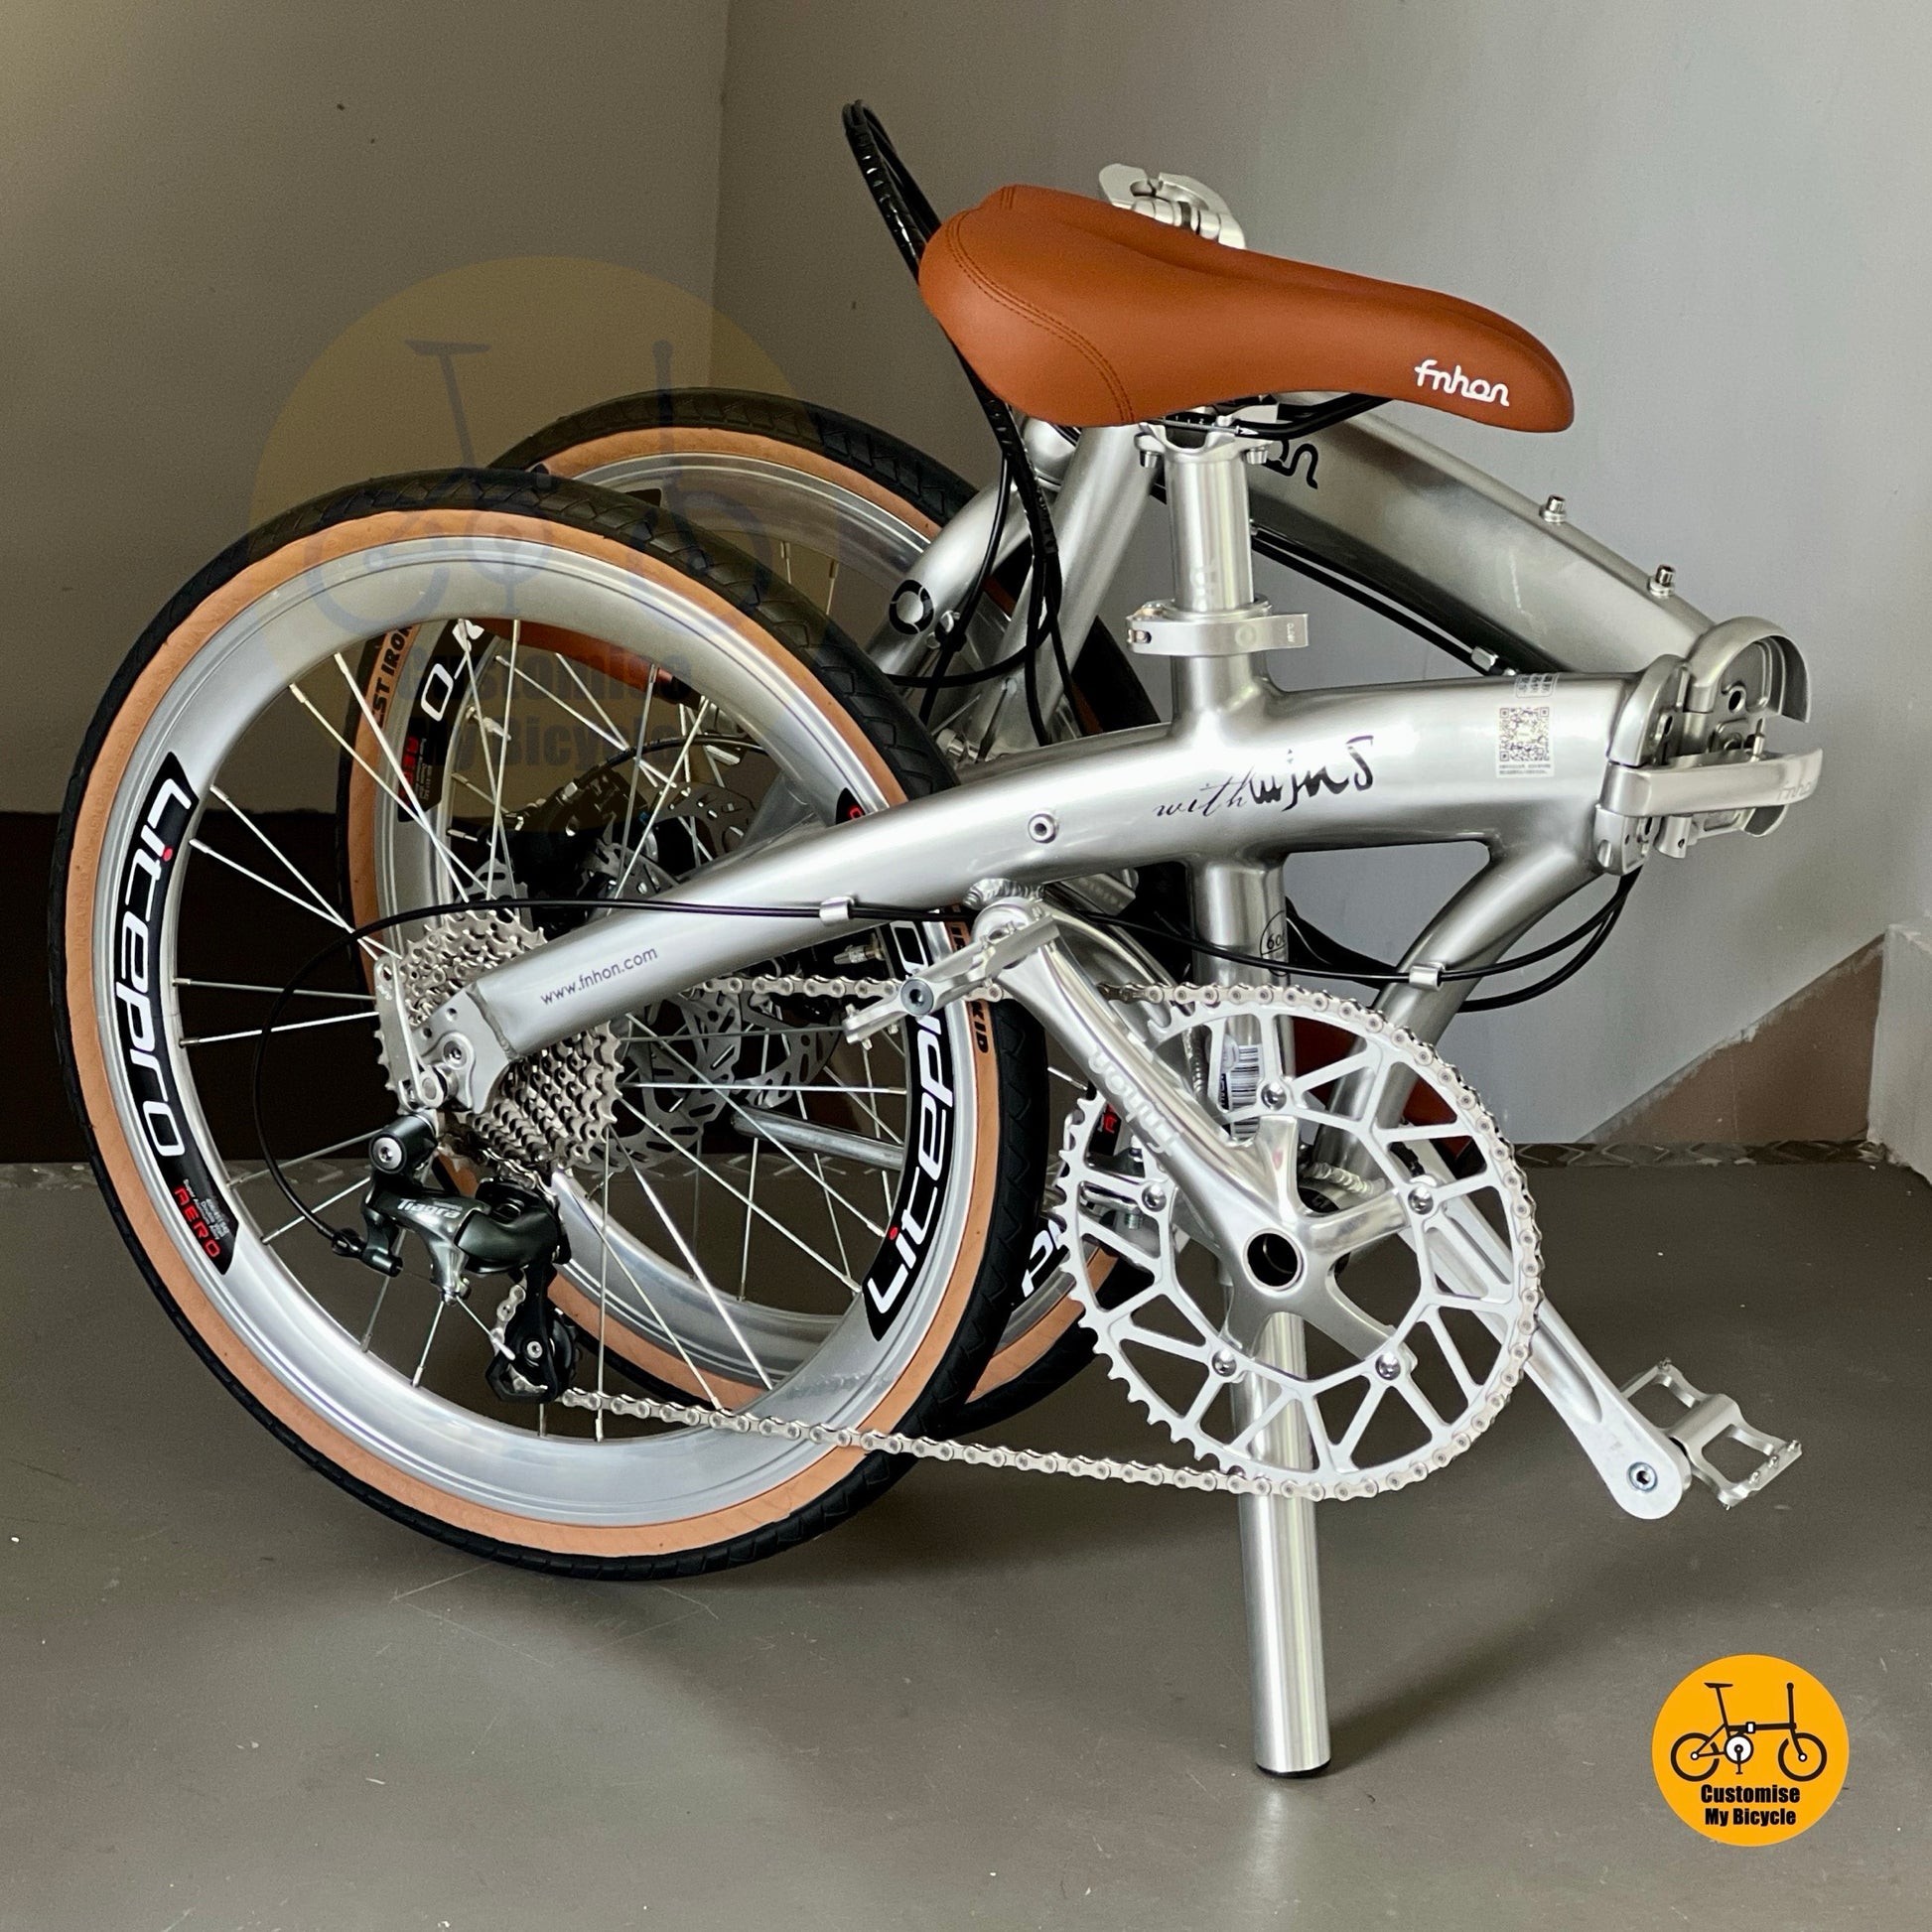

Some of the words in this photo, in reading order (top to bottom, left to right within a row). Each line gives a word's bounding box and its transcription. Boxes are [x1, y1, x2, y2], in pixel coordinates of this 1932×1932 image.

[1414, 358, 1510, 407] fnhon
[115, 778, 192, 1158] Litepro
[540, 948, 658, 1006] www.fnhon.com
[1088, 1048, 1173, 1157] fnhon
[174, 1187, 220, 1258] AERO
[397, 1197, 461, 1219] Tiagra
